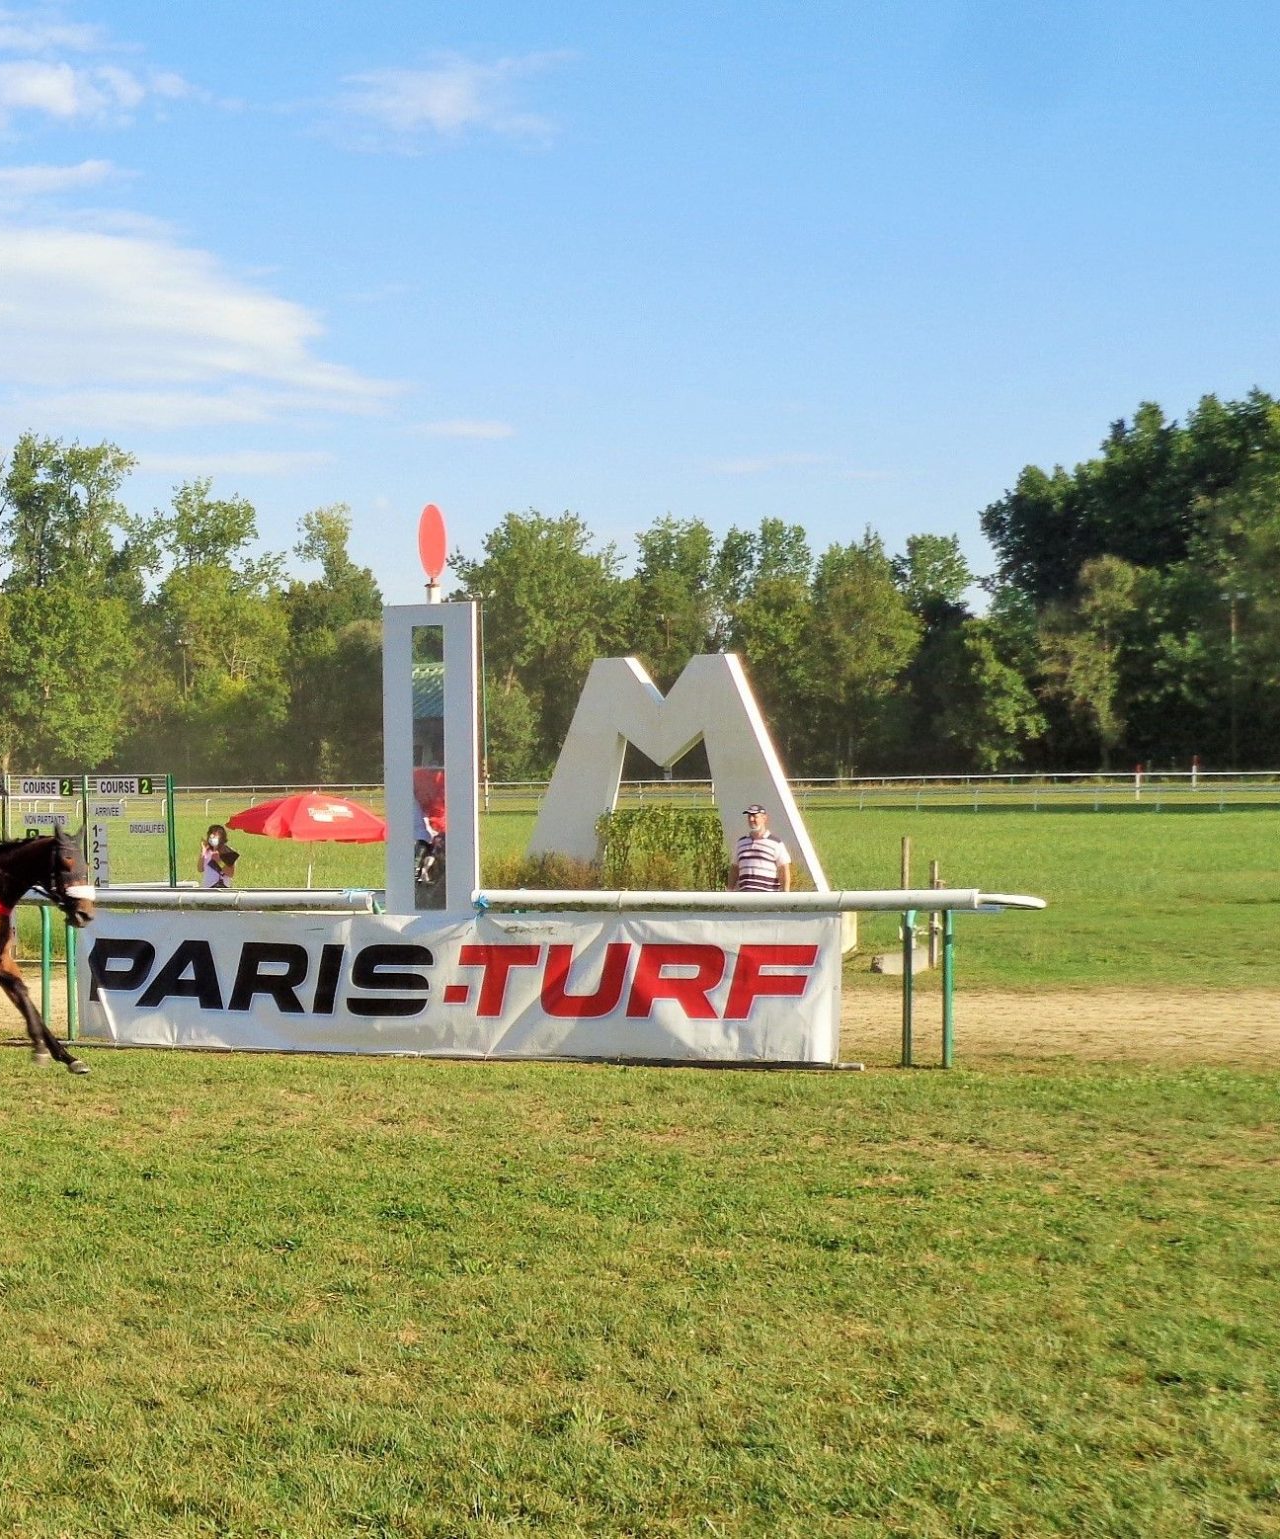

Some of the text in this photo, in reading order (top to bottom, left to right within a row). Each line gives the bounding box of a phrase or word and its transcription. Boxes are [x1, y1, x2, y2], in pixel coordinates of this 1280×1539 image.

[23, 780, 70, 795] COURSE 2
[100, 779, 149, 794] COURSE 2
[24, 815, 65, 825] NON PARTANTS
[88, 937, 819, 1020] PARIS-TURF
